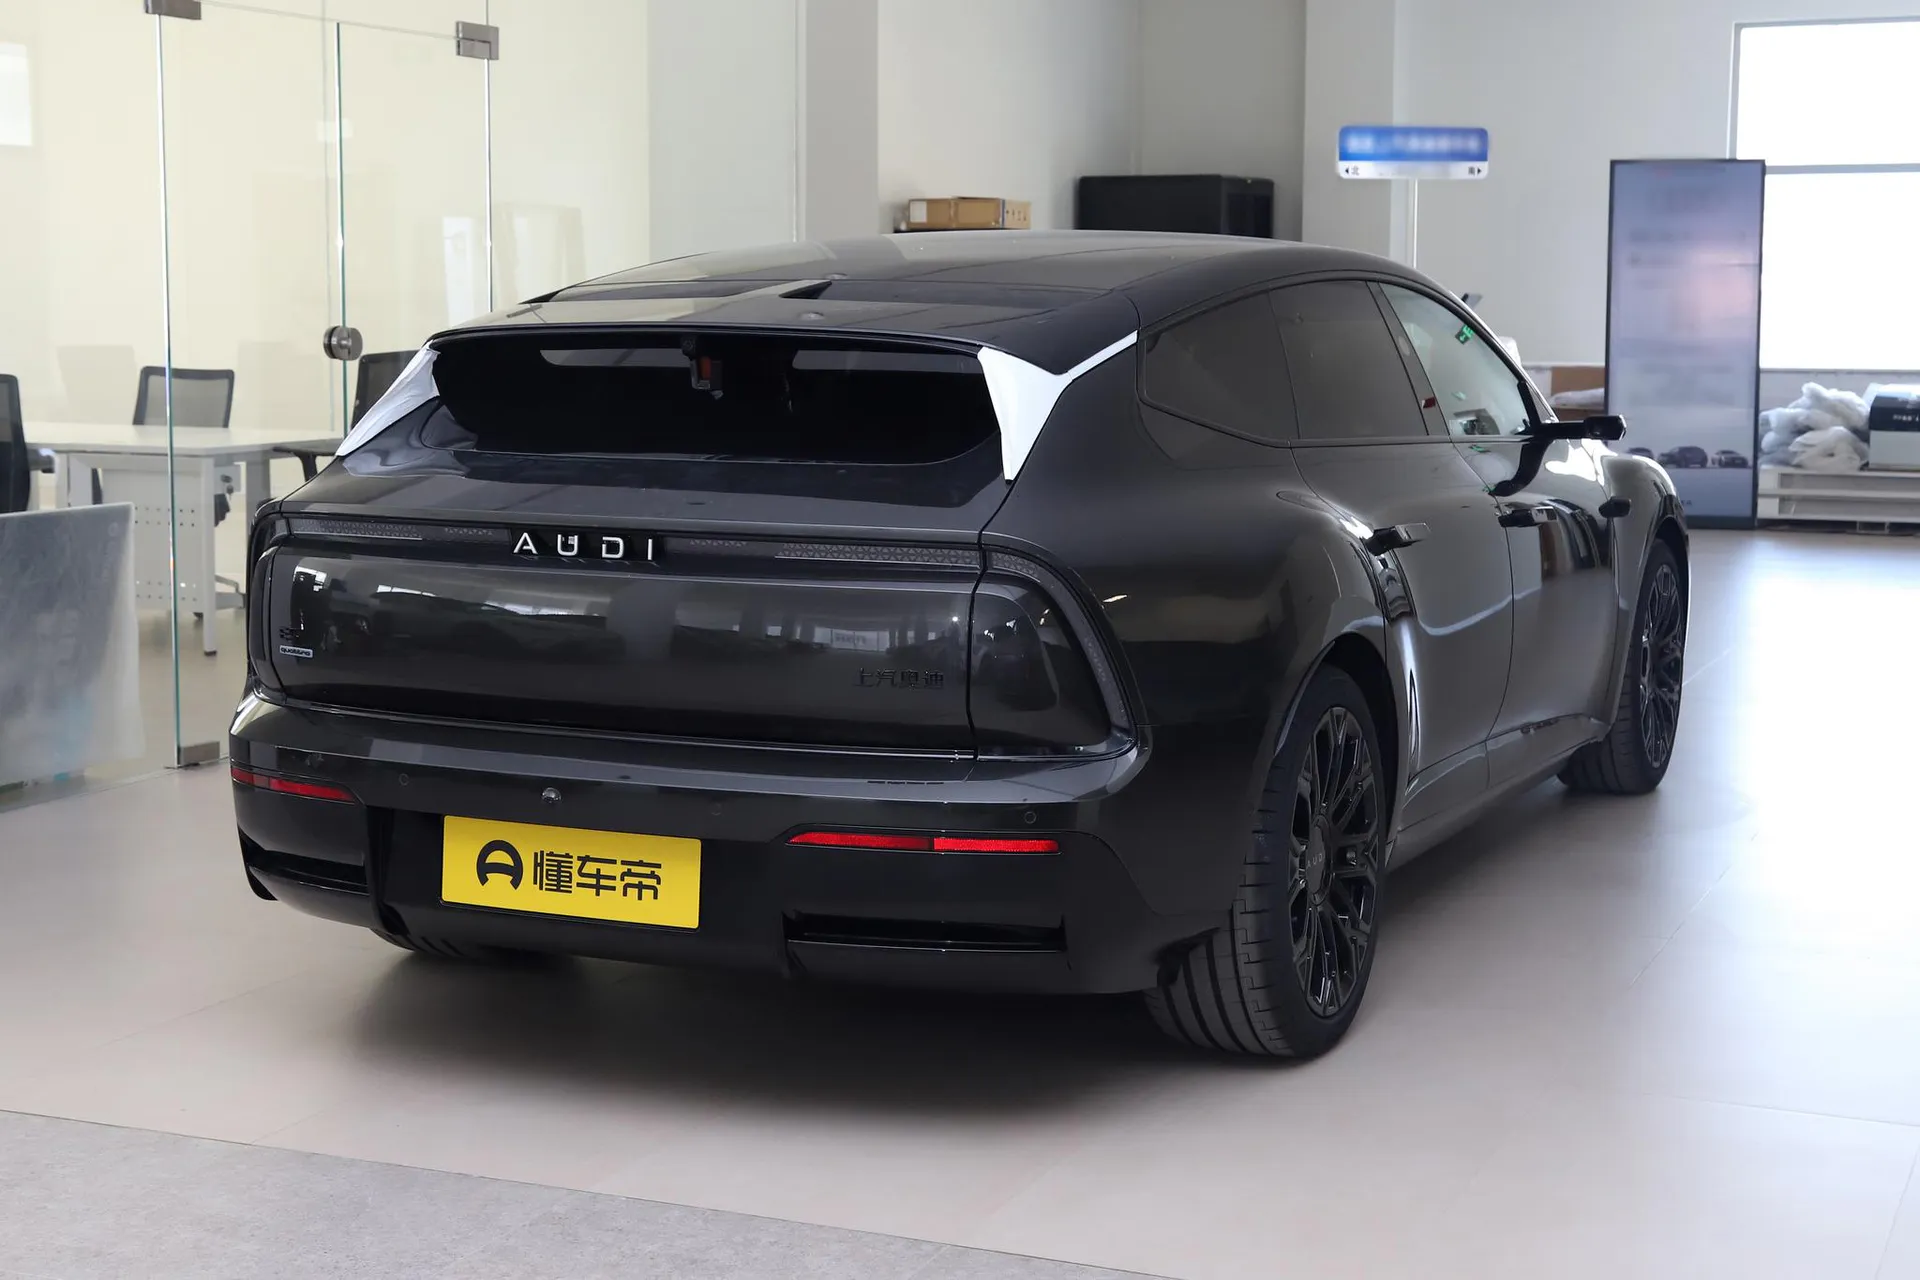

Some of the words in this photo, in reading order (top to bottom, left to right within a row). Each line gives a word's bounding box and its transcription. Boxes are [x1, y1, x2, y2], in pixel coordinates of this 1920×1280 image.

[513, 532, 653, 561] AUDI
[533, 850, 662, 901] 懂车帝
